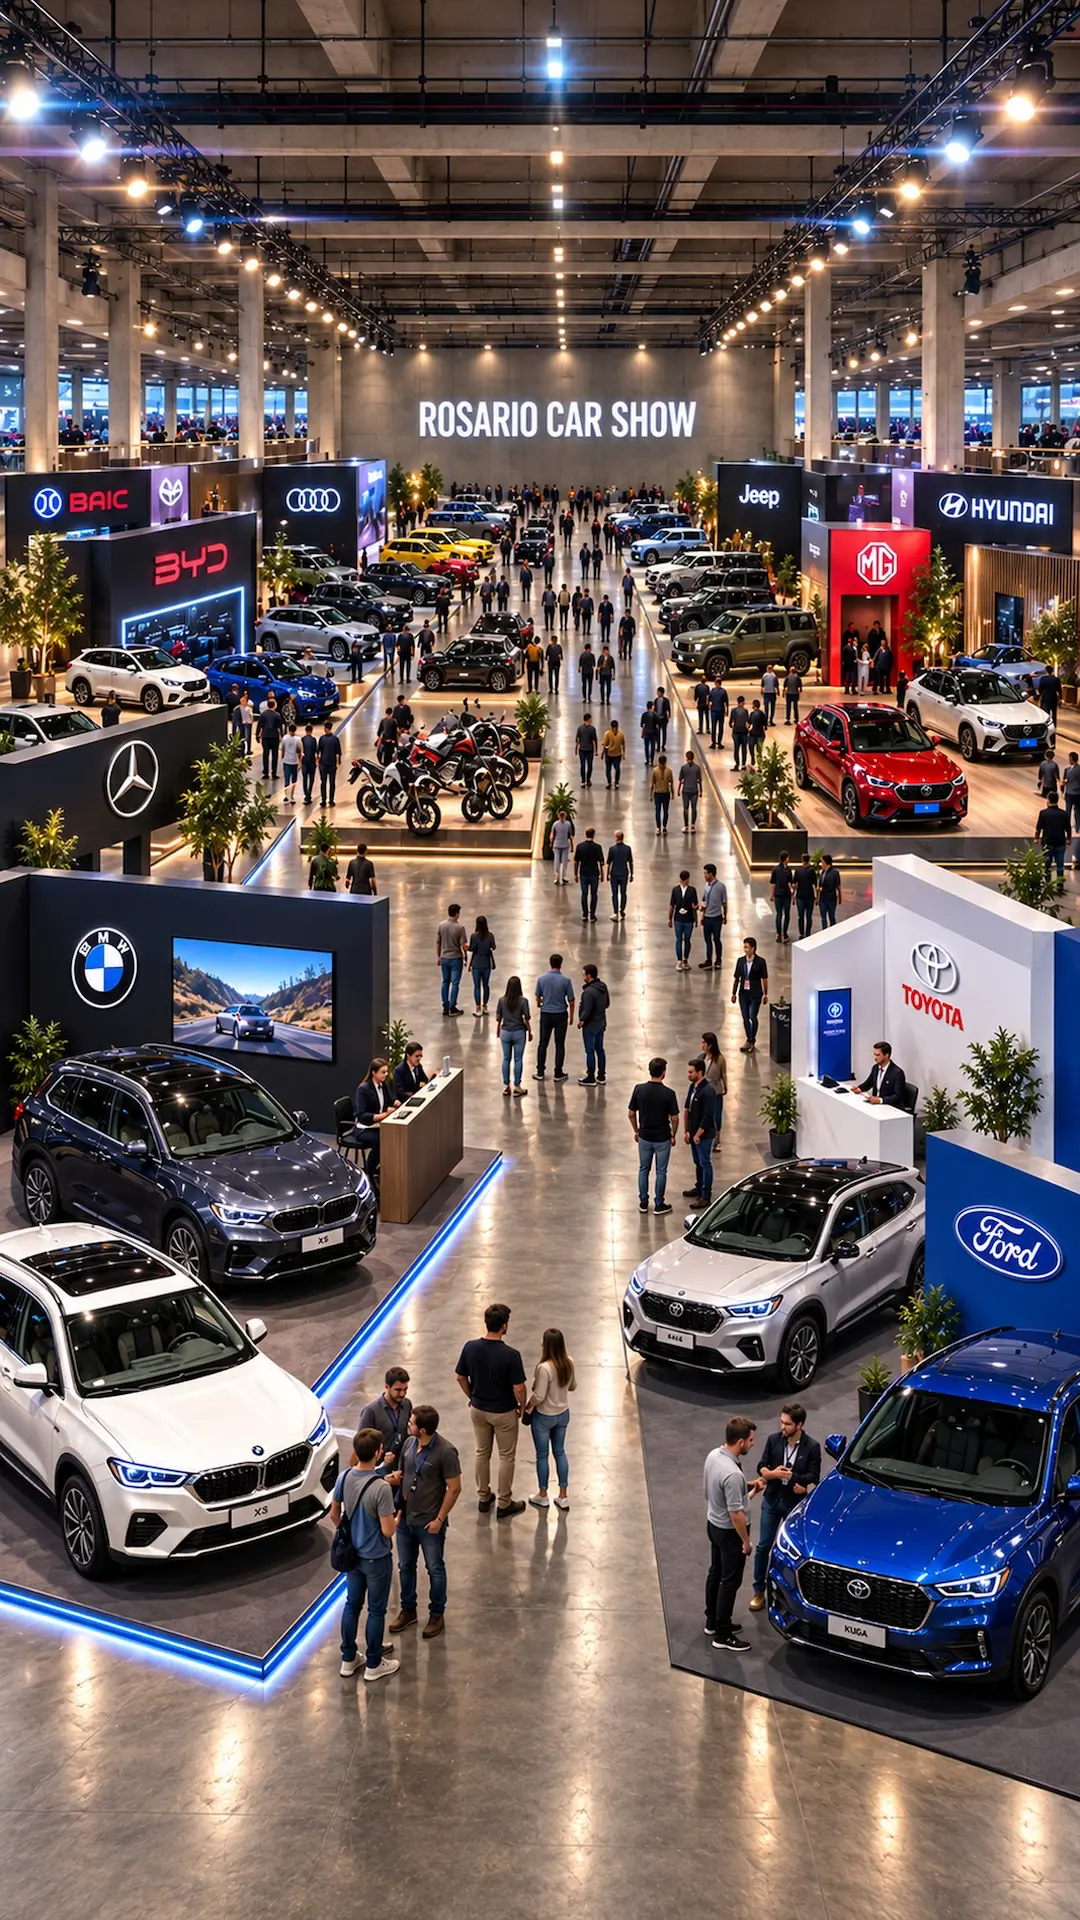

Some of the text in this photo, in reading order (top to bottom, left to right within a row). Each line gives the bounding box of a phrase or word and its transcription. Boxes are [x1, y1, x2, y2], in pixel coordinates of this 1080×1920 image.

[419, 401, 697, 438] ROSARIO CAR SHOW
[69, 488, 129, 513] BAIC
[738, 484, 780, 510] Jeep
[971, 498, 1054, 525] HYUNDAI
[154, 542, 229, 586] BYD
[860, 545, 894, 583] MG
[902, 983, 965, 1032] TOYOTA
[972, 1215, 1041, 1271] Ford
[844, 1624, 869, 1638] KUGA
